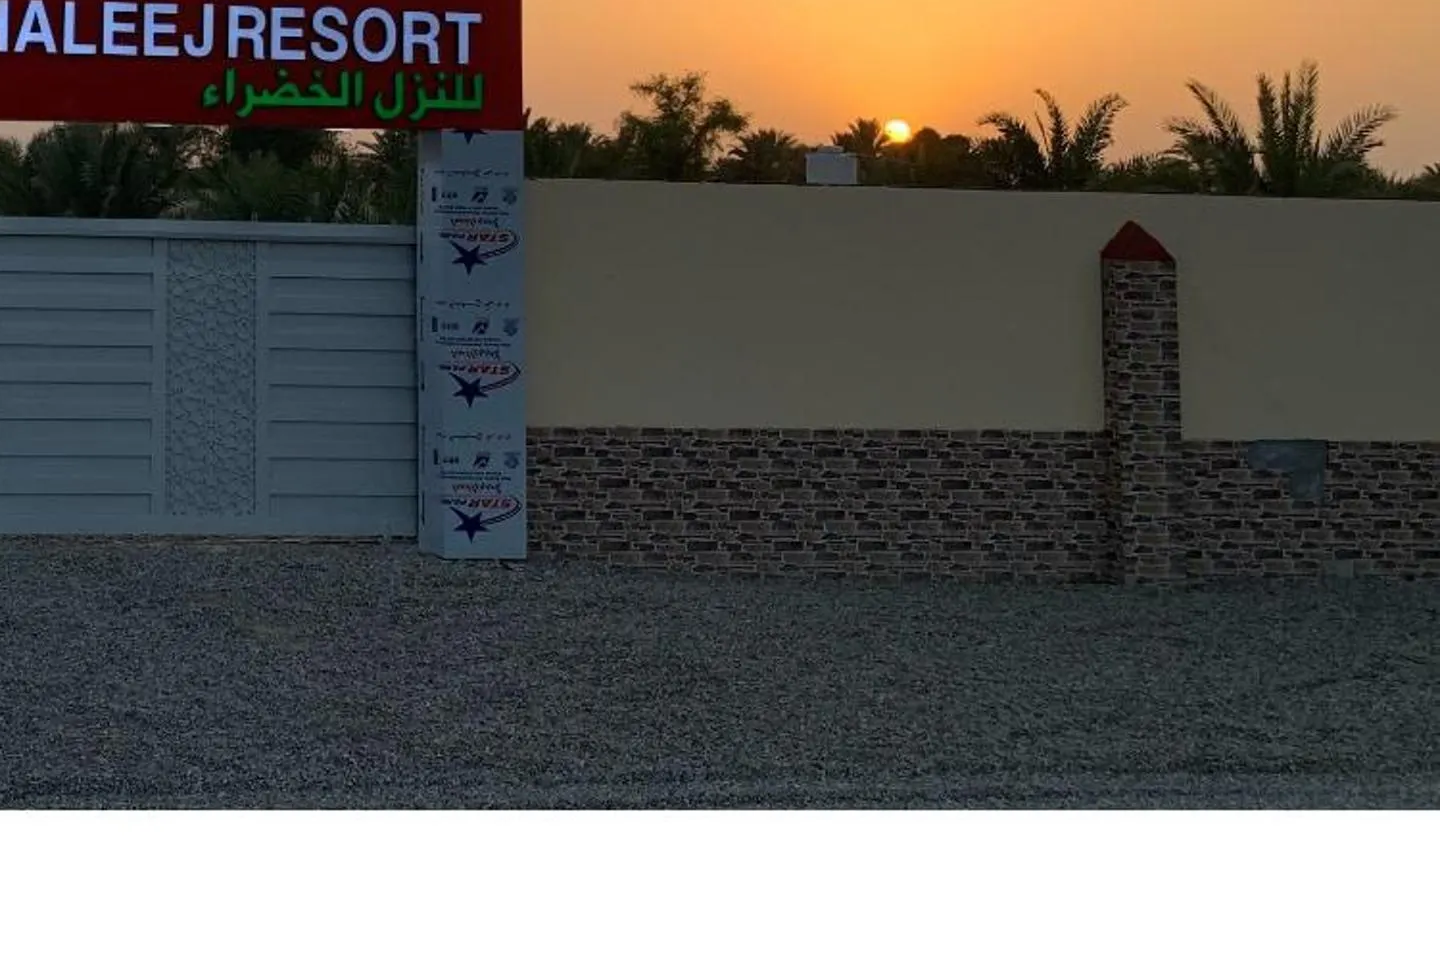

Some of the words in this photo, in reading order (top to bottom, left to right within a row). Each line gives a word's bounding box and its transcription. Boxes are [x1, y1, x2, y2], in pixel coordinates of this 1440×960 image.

[227, 4, 482, 66] RESORT
[201, 67, 364, 118] الخضراء
[373, 71, 484, 121] للنزل
